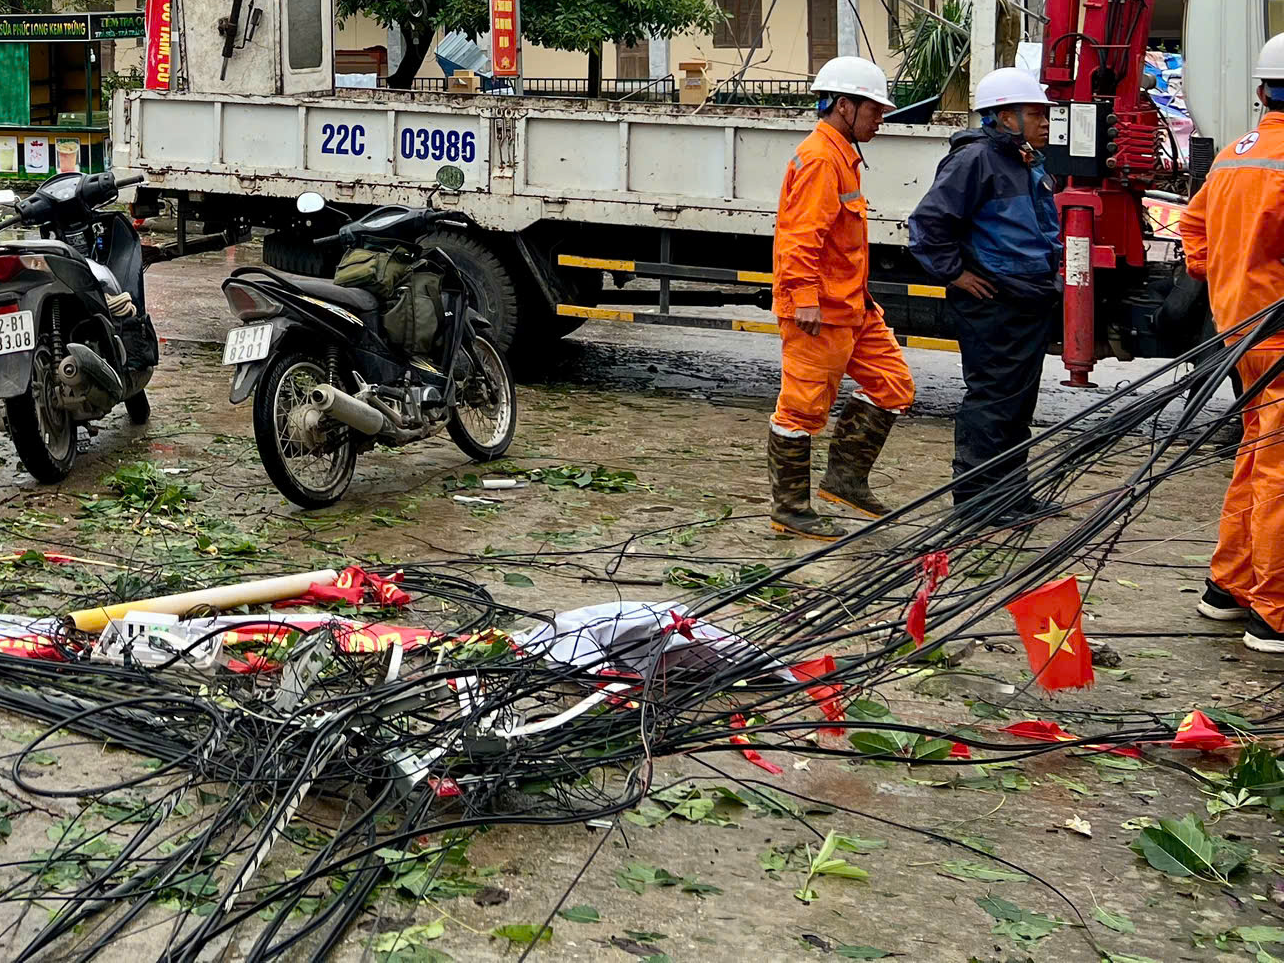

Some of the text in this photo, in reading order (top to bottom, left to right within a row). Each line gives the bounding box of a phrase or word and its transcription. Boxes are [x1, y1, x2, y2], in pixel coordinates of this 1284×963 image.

[31, 22, 48, 35] LONG
[49, 22, 63, 35] KEM
[321, 123, 476, 163] 22C 03986
[235, 326, 265, 345] 19-Y1
[229, 342, 262, 361] 8201
